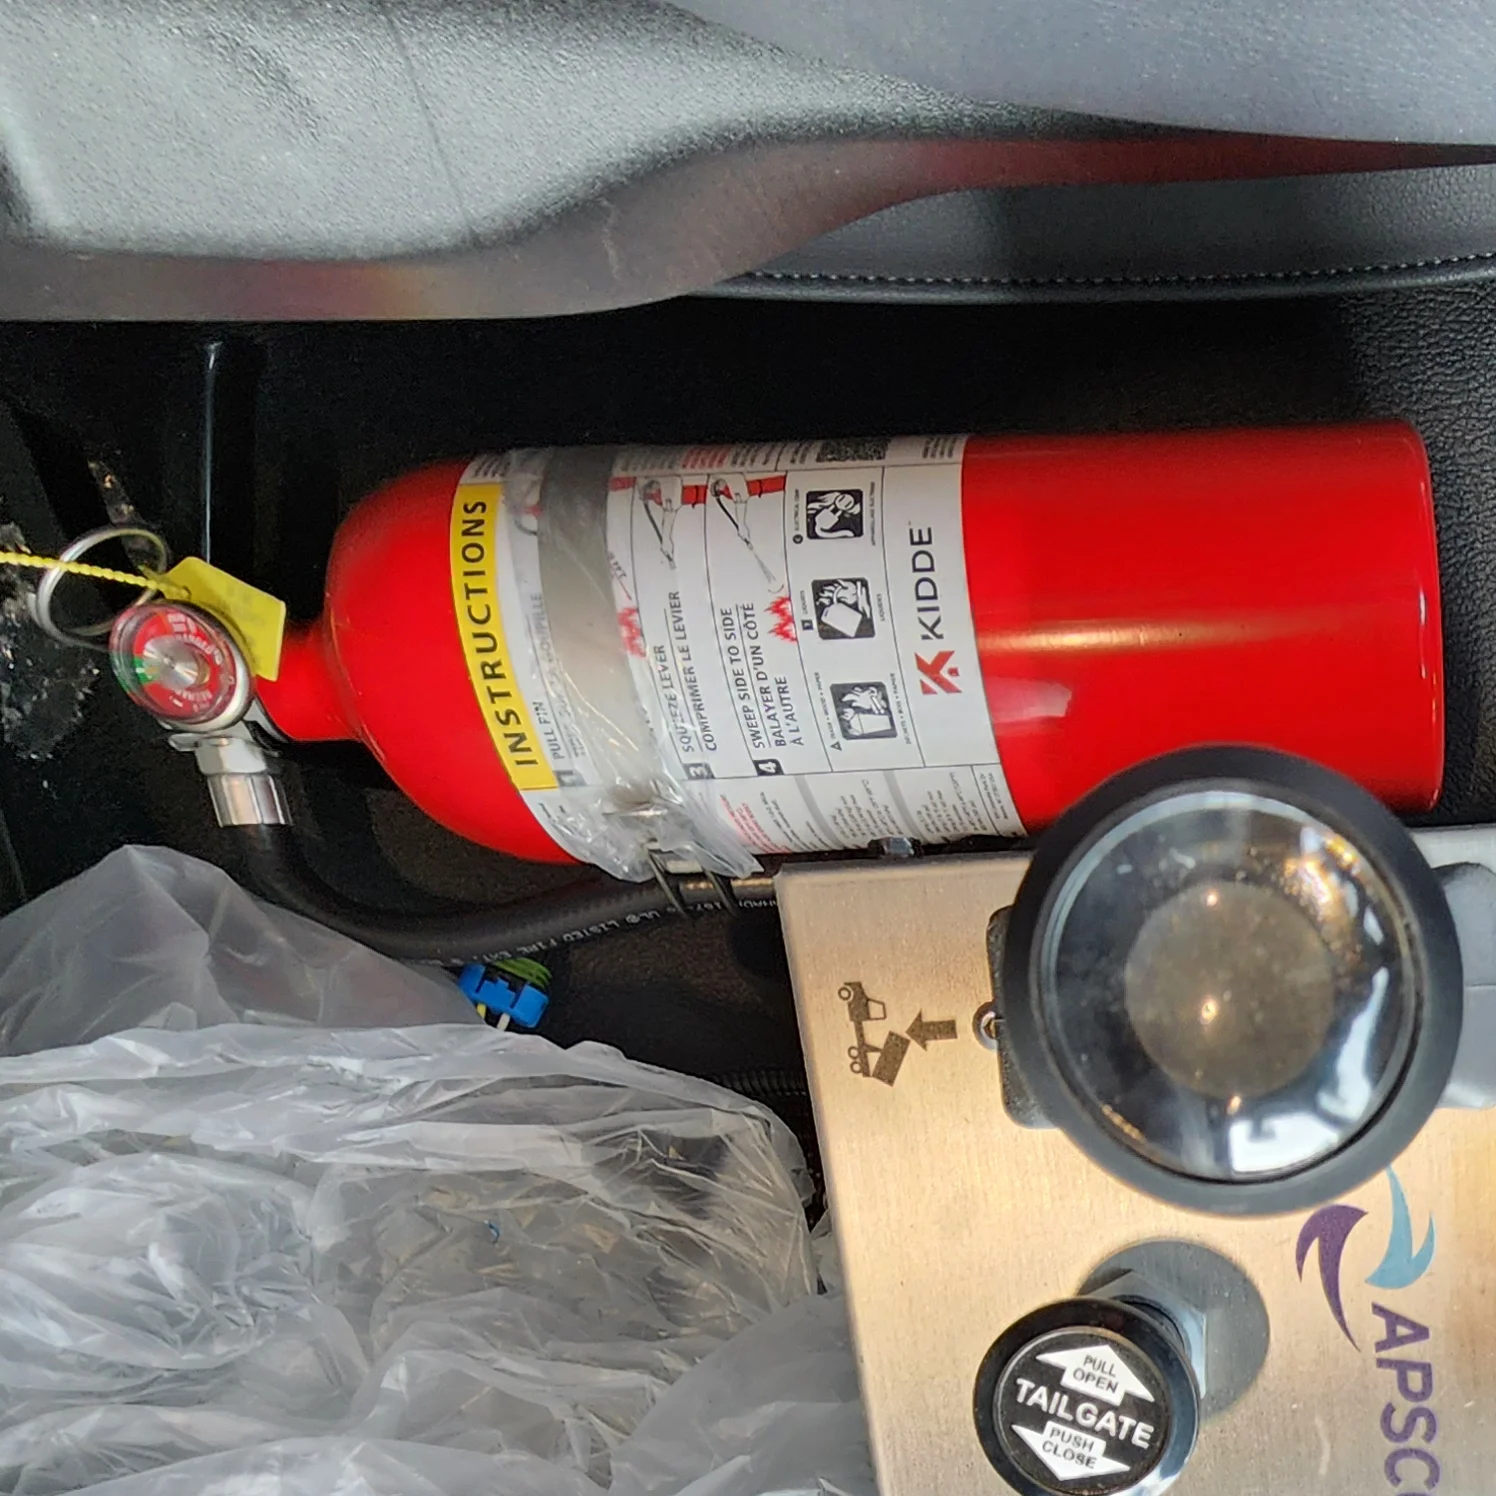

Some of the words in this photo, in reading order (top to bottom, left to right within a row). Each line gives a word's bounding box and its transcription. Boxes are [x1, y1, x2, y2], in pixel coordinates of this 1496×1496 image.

[909, 527, 944, 640] KIDDE
[668, 591, 687, 640] LEVIER
[720, 608, 737, 640] SIDE
[461, 500, 538, 766] INSTRUCTIONS
[653, 645, 674, 690] LEVER
[679, 645, 692, 662] LE
[728, 645, 741, 664] TO
[750, 645, 768, 681] D'UN
[733, 668, 751, 700] SIDE
[683, 666, 717, 751] COMPRIMER
[759, 685, 787, 746] BALAYER
[775, 676, 800, 733] L'AUTRE
[742, 705, 765, 748] SWEEP
[544, 729, 565, 760] PULL
[758, 761, 777, 773] 4
[1073, 1368, 1119, 1394] OPEN
[1084, 1354, 1116, 1377] PULL
[1016, 1378, 1154, 1449] TAILGATE
[1042, 1441, 1097, 1470] CLOSE
[1050, 1428, 1095, 1452] PUSH
